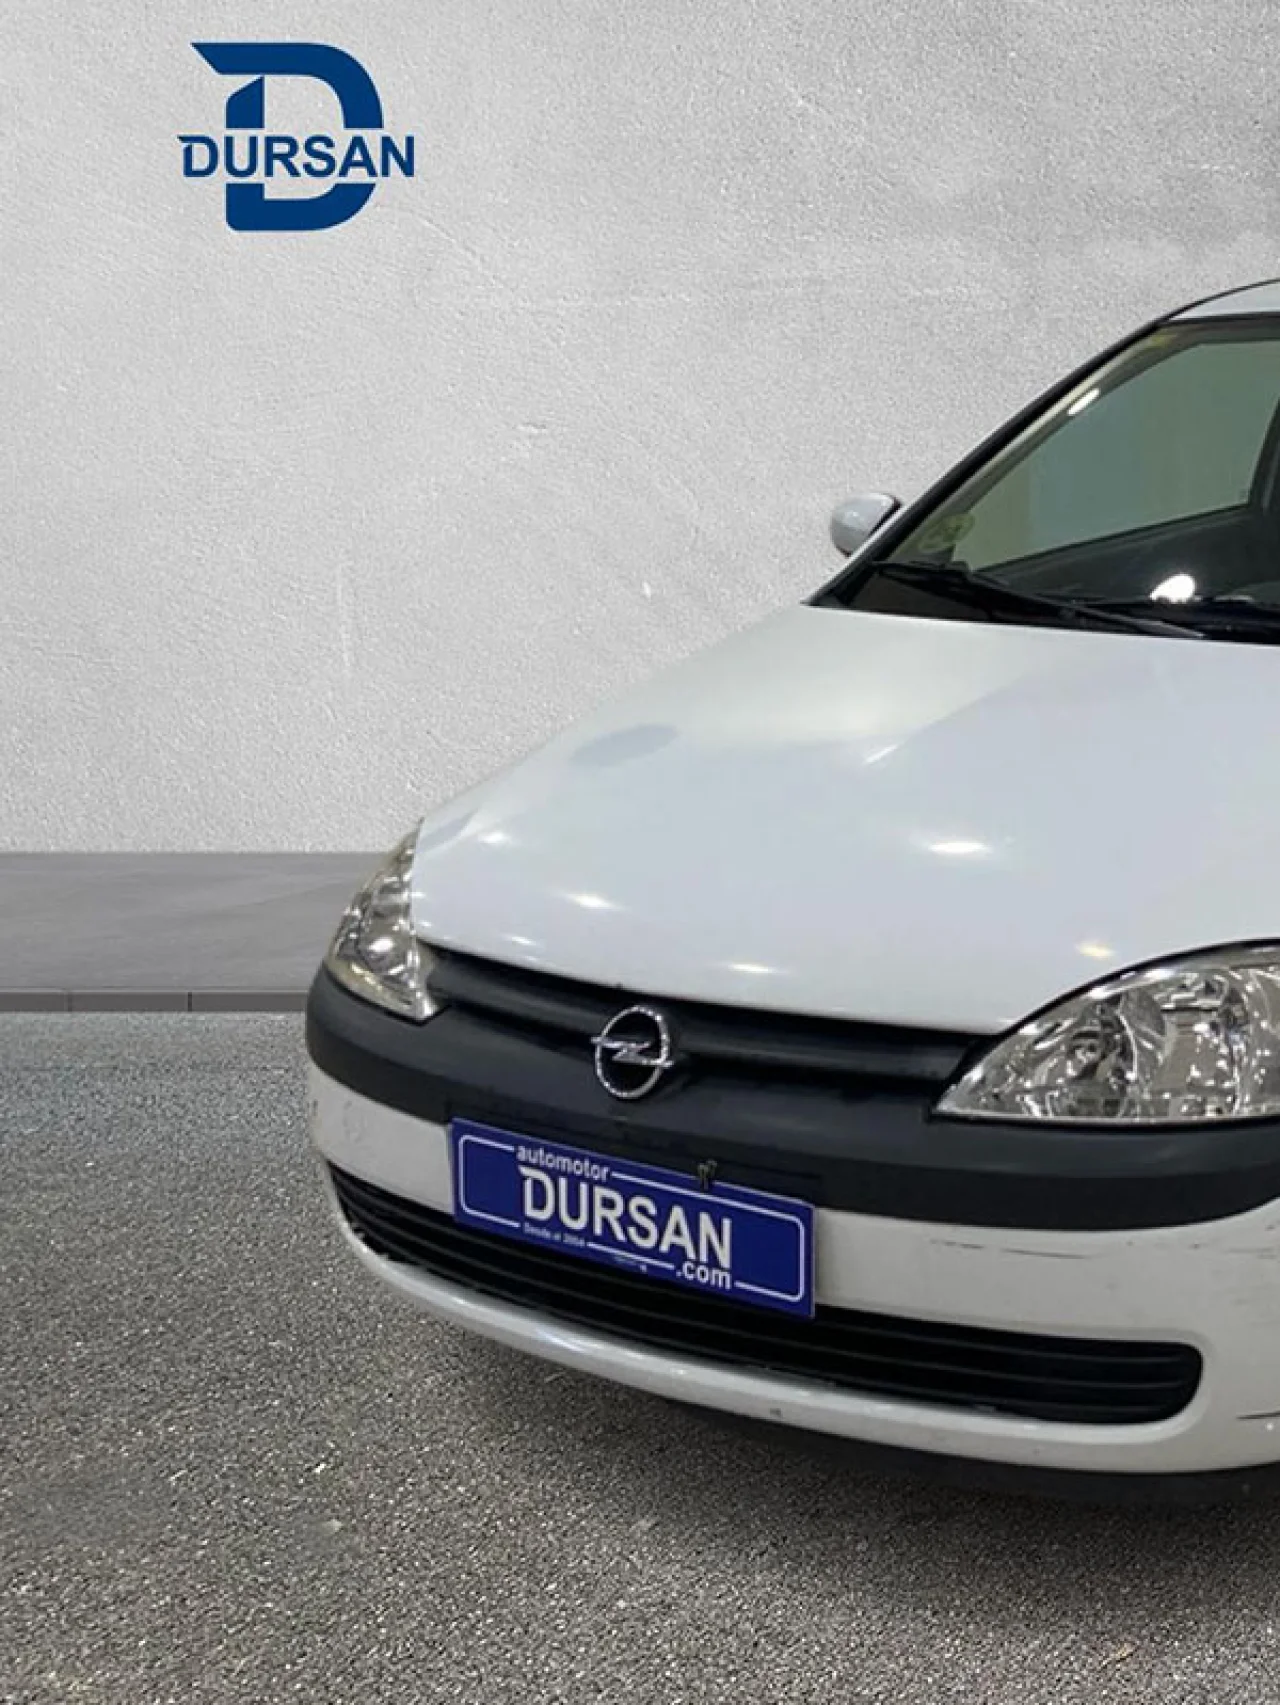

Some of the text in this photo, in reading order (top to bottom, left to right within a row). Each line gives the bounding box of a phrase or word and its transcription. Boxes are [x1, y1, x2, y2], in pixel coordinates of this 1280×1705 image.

[515, 1146, 611, 1181] automotor
[518, 1164, 732, 1269] DURSAN
[676, 1260, 731, 1290] .com
